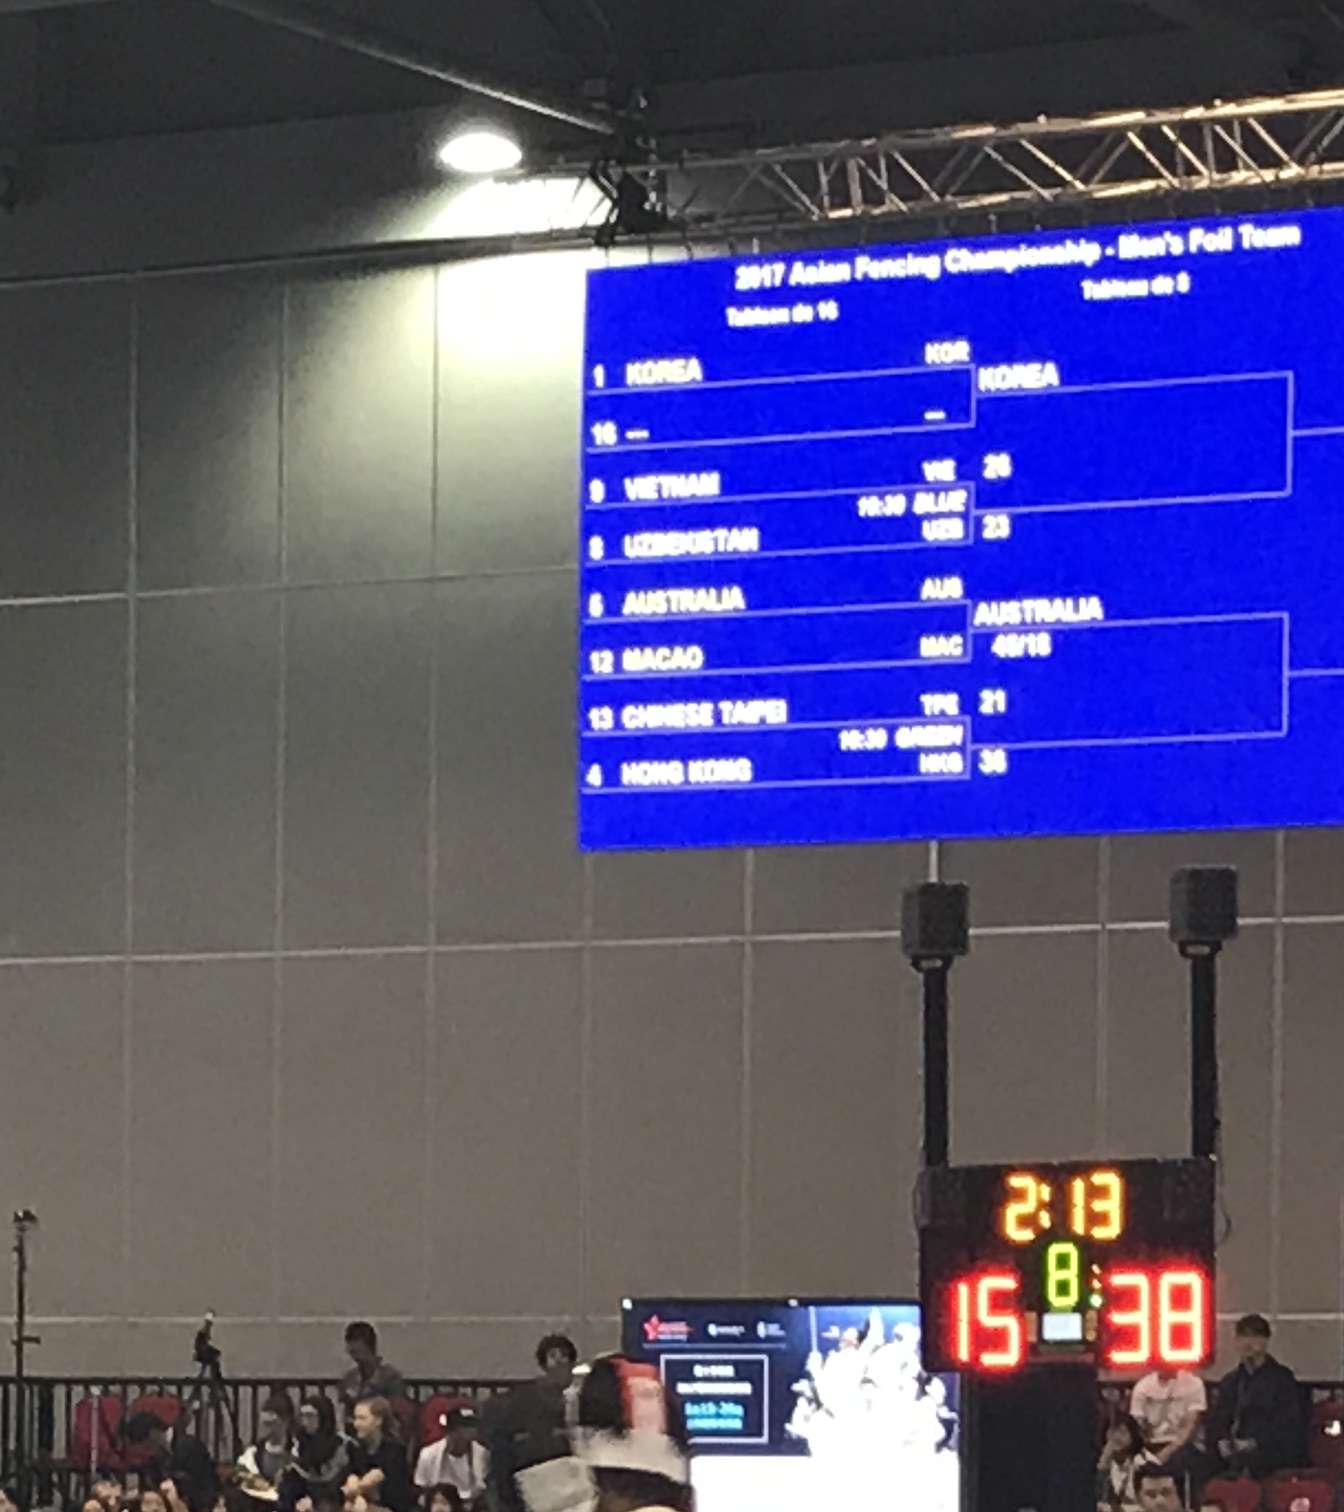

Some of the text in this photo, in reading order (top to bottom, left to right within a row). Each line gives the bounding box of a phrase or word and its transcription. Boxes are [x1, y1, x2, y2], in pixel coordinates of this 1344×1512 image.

[735, 263, 786, 290] 2017
[789, 260, 853, 286] Asian
[855, 253, 942, 281] Fencing
[944, 239, 1102, 273] Championship
[1118, 229, 1185, 259] Men's
[1188, 226, 1234, 252] Foil
[1238, 223, 1302, 249] Team
[1081, 278, 1148, 300] Tableau
[1151, 274, 1174, 296] de
[726, 306, 789, 327] Tableau
[791, 303, 813, 323] de
[925, 340, 971, 364] KOR
[593, 357, 703, 388] 1 KOREA
[978, 362, 1060, 392] KOREA
[624, 472, 721, 501] VIETNAM
[912, 489, 968, 515] BLUE
[982, 513, 1011, 539] 23
[624, 527, 760, 559] UZBEKISTAN
[622, 586, 746, 616] AUSTRALIA
[973, 596, 1104, 627] AUSTRALIA
[589, 645, 705, 675] 12 MACAO
[919, 634, 964, 658] MAC
[588, 698, 788, 731] 13 CHINESE TAIPEI
[920, 693, 959, 716] TPE
[979, 689, 1006, 714] 21
[586, 757, 753, 788] 4 HONG KONG
[1004, 1171, 1124, 1242] 2:13
[1047, 1241, 1080, 1308] 8
[956, 1270, 1205, 1368] 15 38
